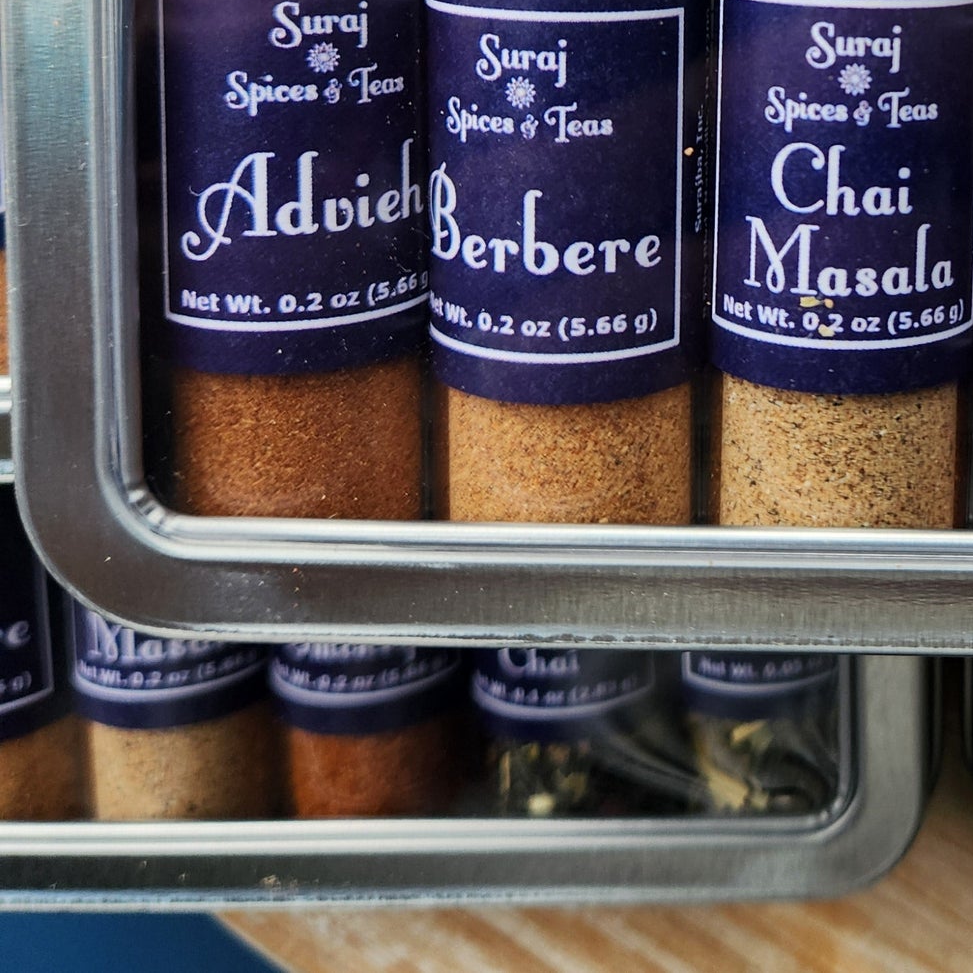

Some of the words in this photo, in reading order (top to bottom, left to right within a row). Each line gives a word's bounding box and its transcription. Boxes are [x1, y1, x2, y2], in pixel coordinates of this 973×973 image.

[269, 1, 368, 48] Suraj
[805, 21, 902, 74] Suraj
[475, 33, 568, 87] Suraj
[224, 71, 318, 116] Spices
[323, 78, 342, 104] &
[349, 63, 404, 104] Teas
[764, 86, 848, 133] Spices
[853, 99, 873, 126] &
[877, 87, 938, 127] Teas
[447, 96, 514, 143] Spices
[520, 114, 539, 139] &
[543, 102, 613, 143] Teas
[181, 138, 424, 261] Advieh
[770, 142, 913, 216] Chai
[430, 162, 661, 275] Berbere
[744, 215, 954, 297] Masala
[181, 290, 218, 312] Net
[225, 294, 271, 315] Wt.
[278, 293, 323, 313] 0.2
[330, 290, 360, 308] oz
[367, 273, 417, 306] (5.66
[723, 293, 753, 320] Net
[757, 306, 795, 328] Wt.
[802, 311, 844, 333] 02
[851, 317, 881, 333] oz
[887, 305, 945, 335] (5.66
[950, 298, 964, 324] g)
[445, 301, 473, 327] Wt.
[478, 311, 514, 335] 0.2
[521, 319, 551, 337] oz
[558, 312, 627, 341] (5.66
[634, 308, 658, 333] g)
